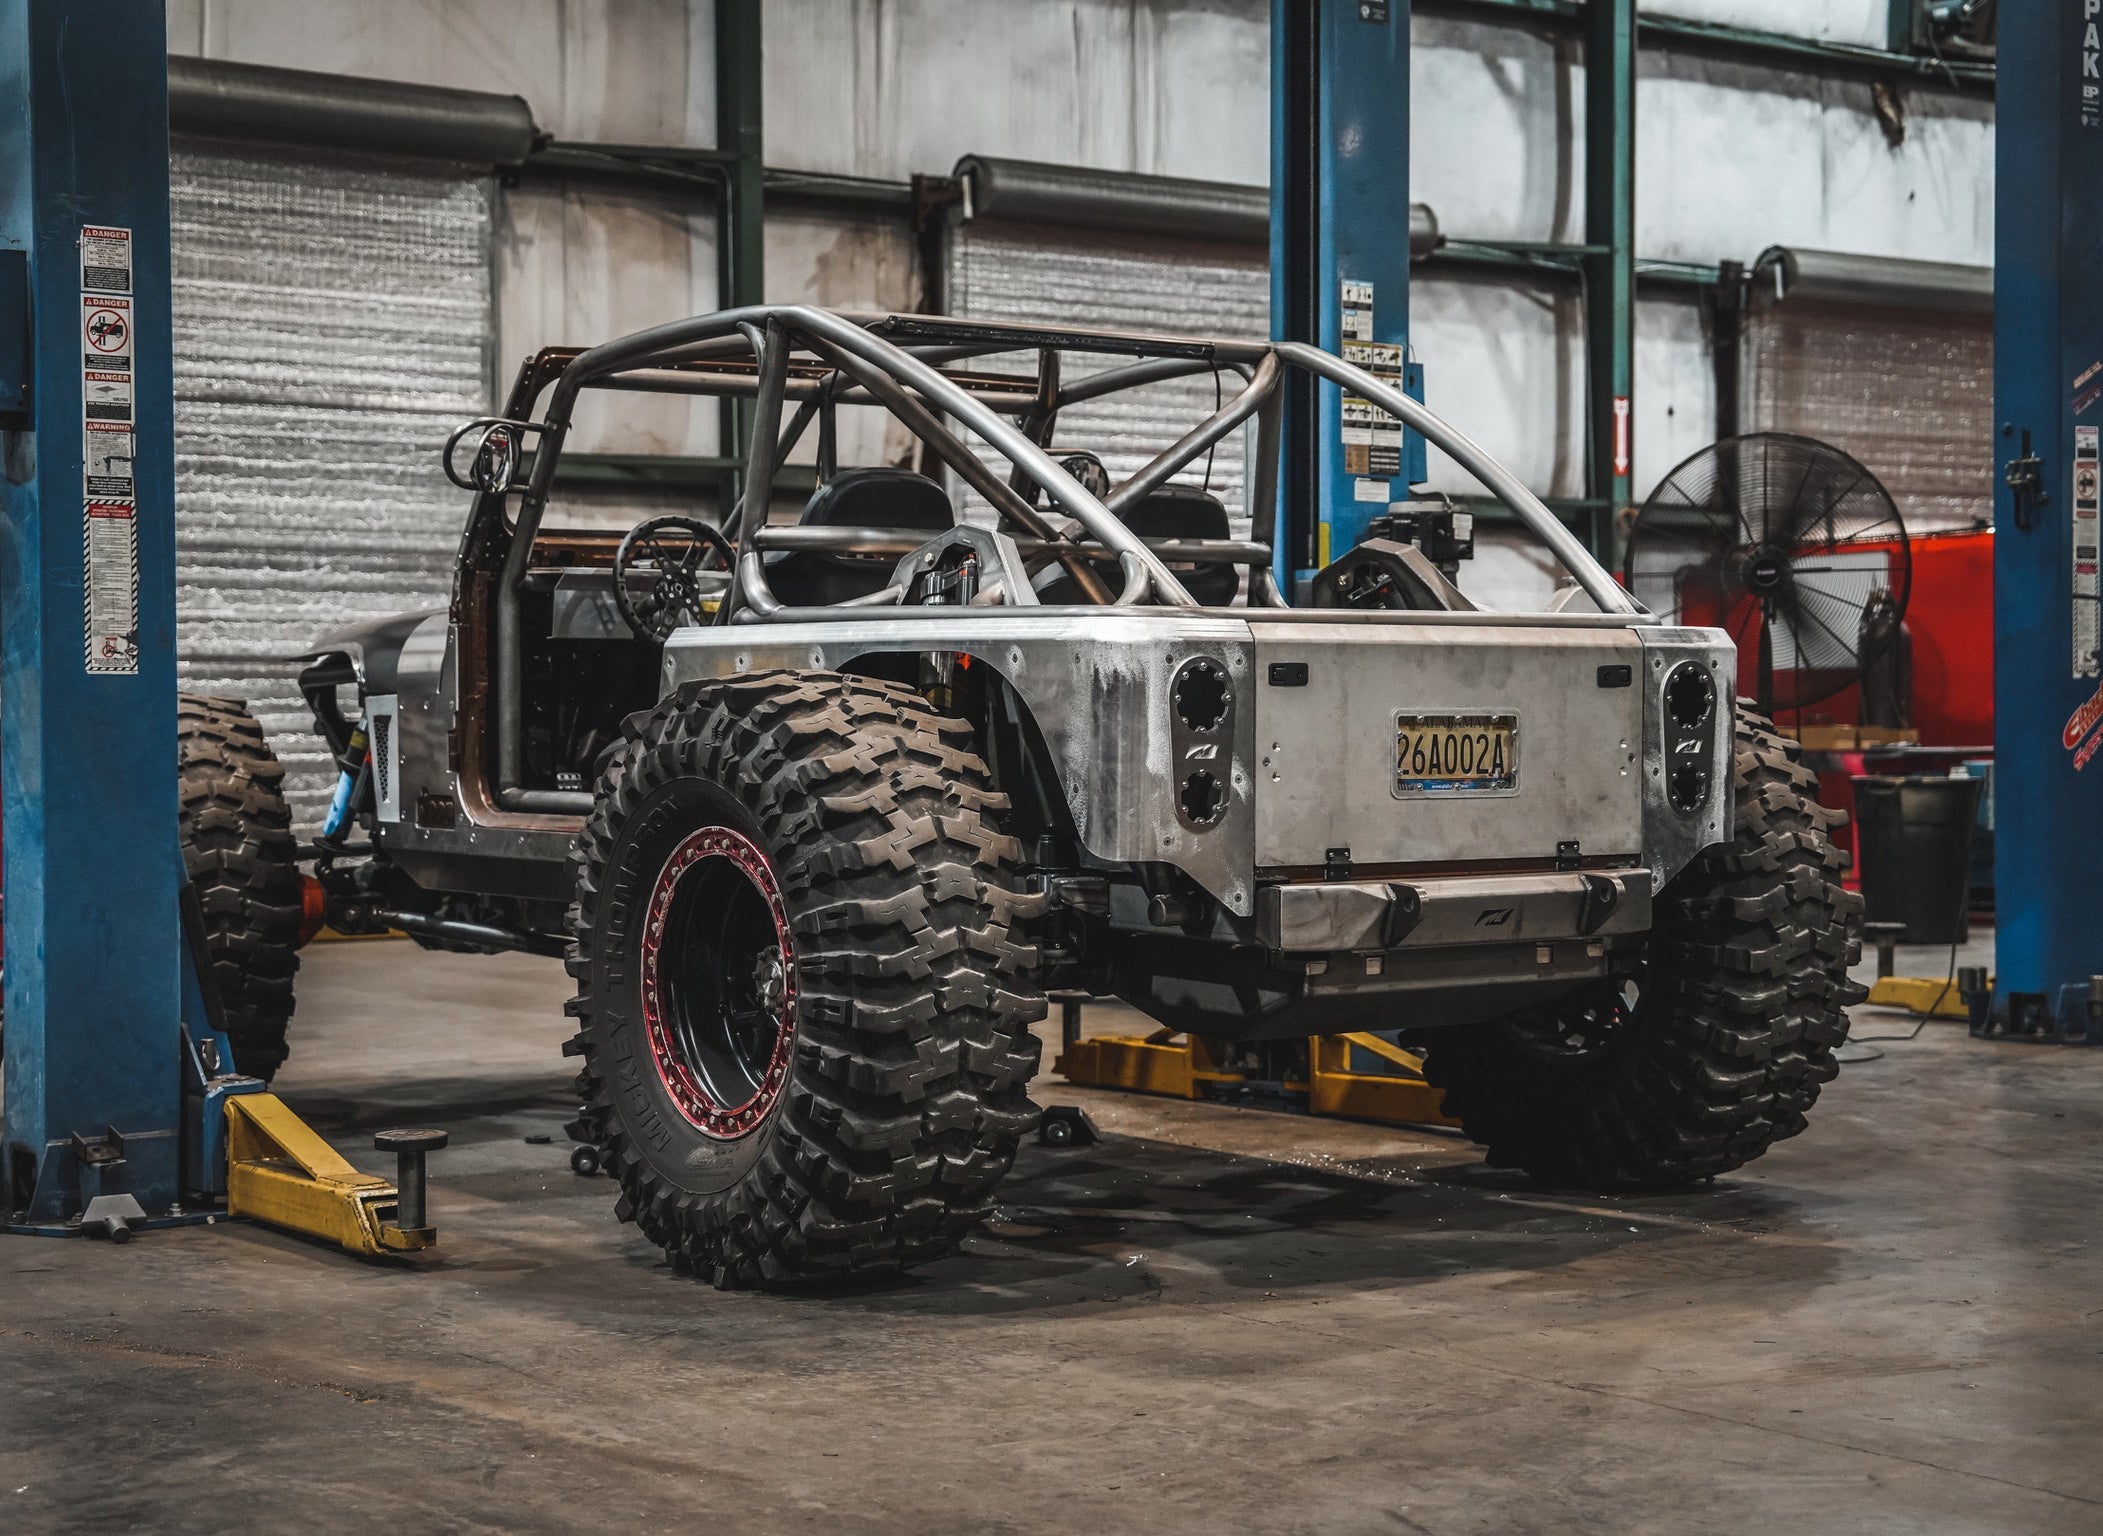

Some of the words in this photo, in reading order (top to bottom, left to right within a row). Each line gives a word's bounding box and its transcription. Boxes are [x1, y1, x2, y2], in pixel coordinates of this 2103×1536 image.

[93, 230, 127, 239] DANGER
[93, 299, 128, 307] DANGER
[94, 373, 129, 381] DANGER
[1398, 733, 1505, 775] 26A002A
[606, 1009, 673, 1153] MICKEY
